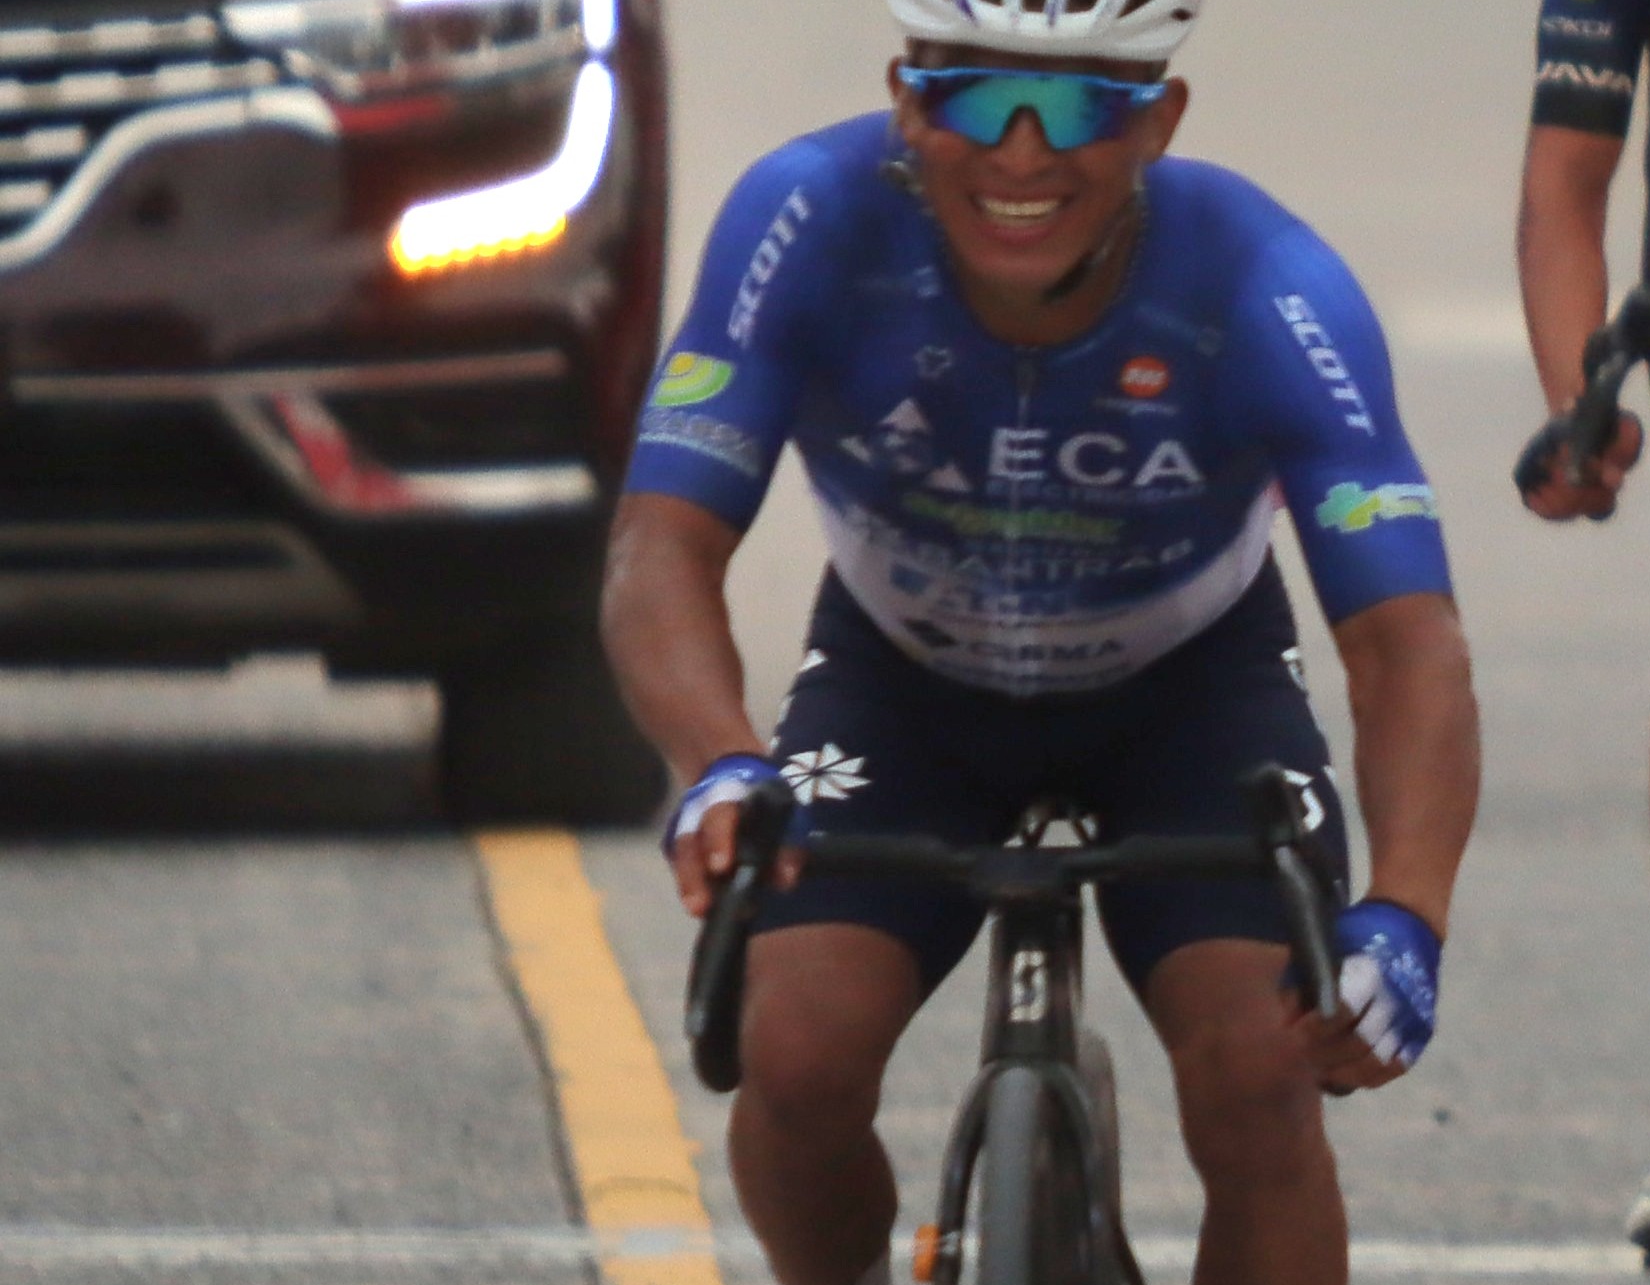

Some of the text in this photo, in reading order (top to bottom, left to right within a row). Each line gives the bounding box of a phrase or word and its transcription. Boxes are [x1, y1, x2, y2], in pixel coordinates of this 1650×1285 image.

[727, 185, 812, 348] SCOTT
[1273, 294, 1377, 438] SCOTT
[988, 428, 1209, 488] ECA
